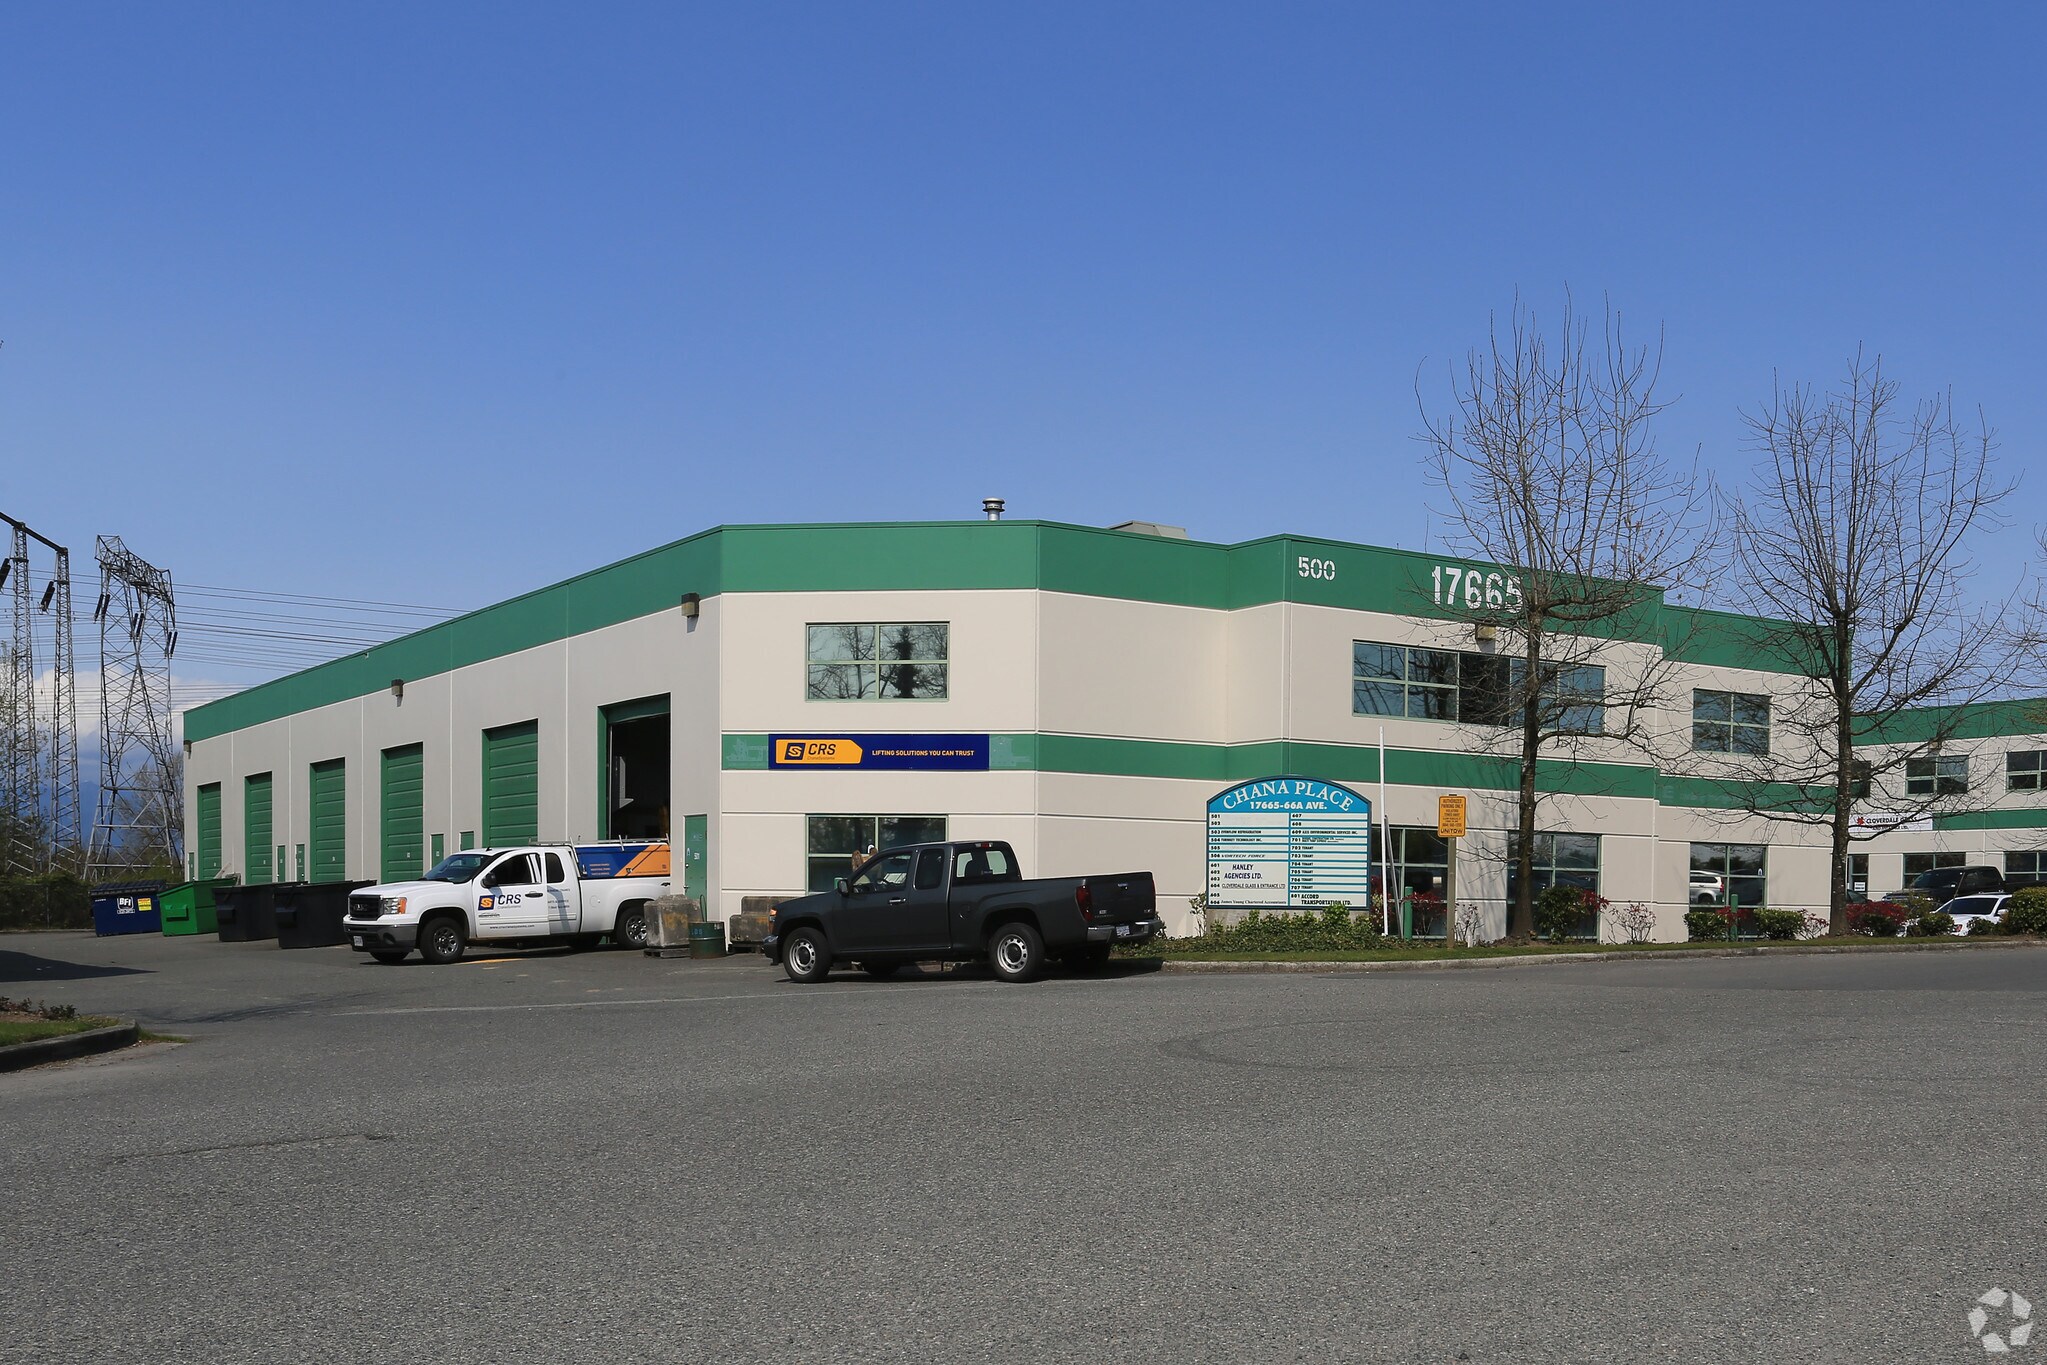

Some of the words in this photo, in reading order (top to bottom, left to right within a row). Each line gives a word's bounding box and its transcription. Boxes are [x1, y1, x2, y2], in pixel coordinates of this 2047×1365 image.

[1298, 556, 1336, 581] 500
[1431, 565, 1523, 614] 17665
[808, 743, 836, 755] CRS
[1223, 780, 1290, 810] CHANA
[1294, 781, 1354, 811] PLACE
[1250, 801, 1303, 810] 17665-66A
[1305, 801, 1327, 810] AVE.
[119, 897, 131, 906] BFI
[498, 894, 522, 905] CRS
